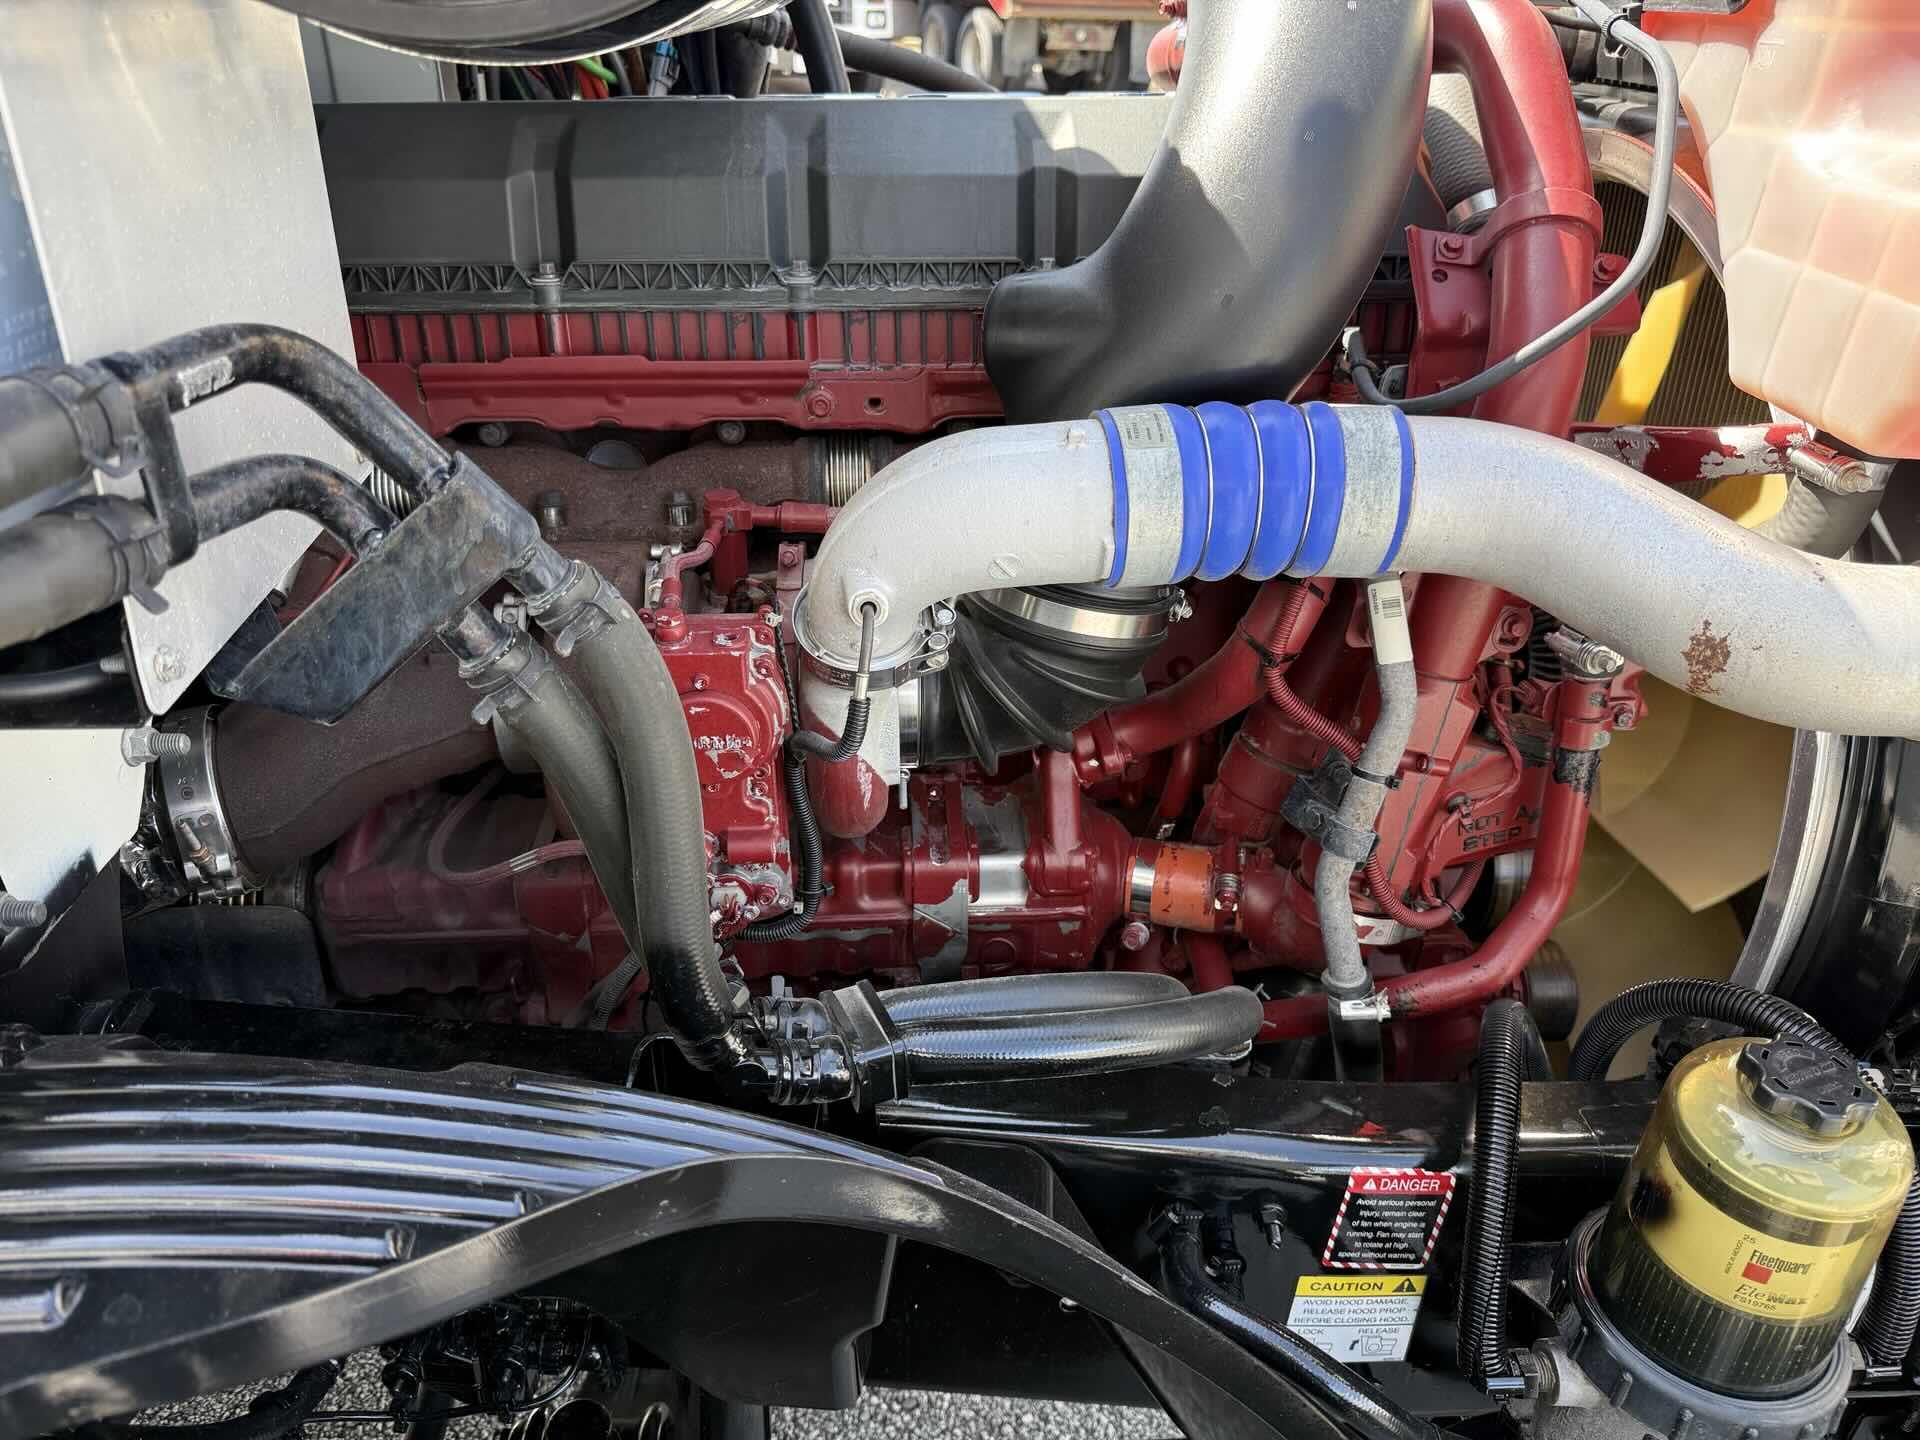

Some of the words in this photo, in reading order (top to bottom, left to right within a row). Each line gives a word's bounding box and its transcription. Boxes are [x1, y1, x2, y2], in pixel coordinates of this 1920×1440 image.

[1463, 826, 1521, 852] STEP
[1379, 1178, 1440, 1191] DANGER
[1404, 1199, 1437, 1208] personal
[1393, 1221, 1418, 1229] engine
[1346, 1231, 1374, 1239] running.
[1387, 1252, 1416, 1260] warning.
[1749, 1248, 1812, 1275] Fleetguard
[1310, 1282, 1385, 1292] CAUTION
